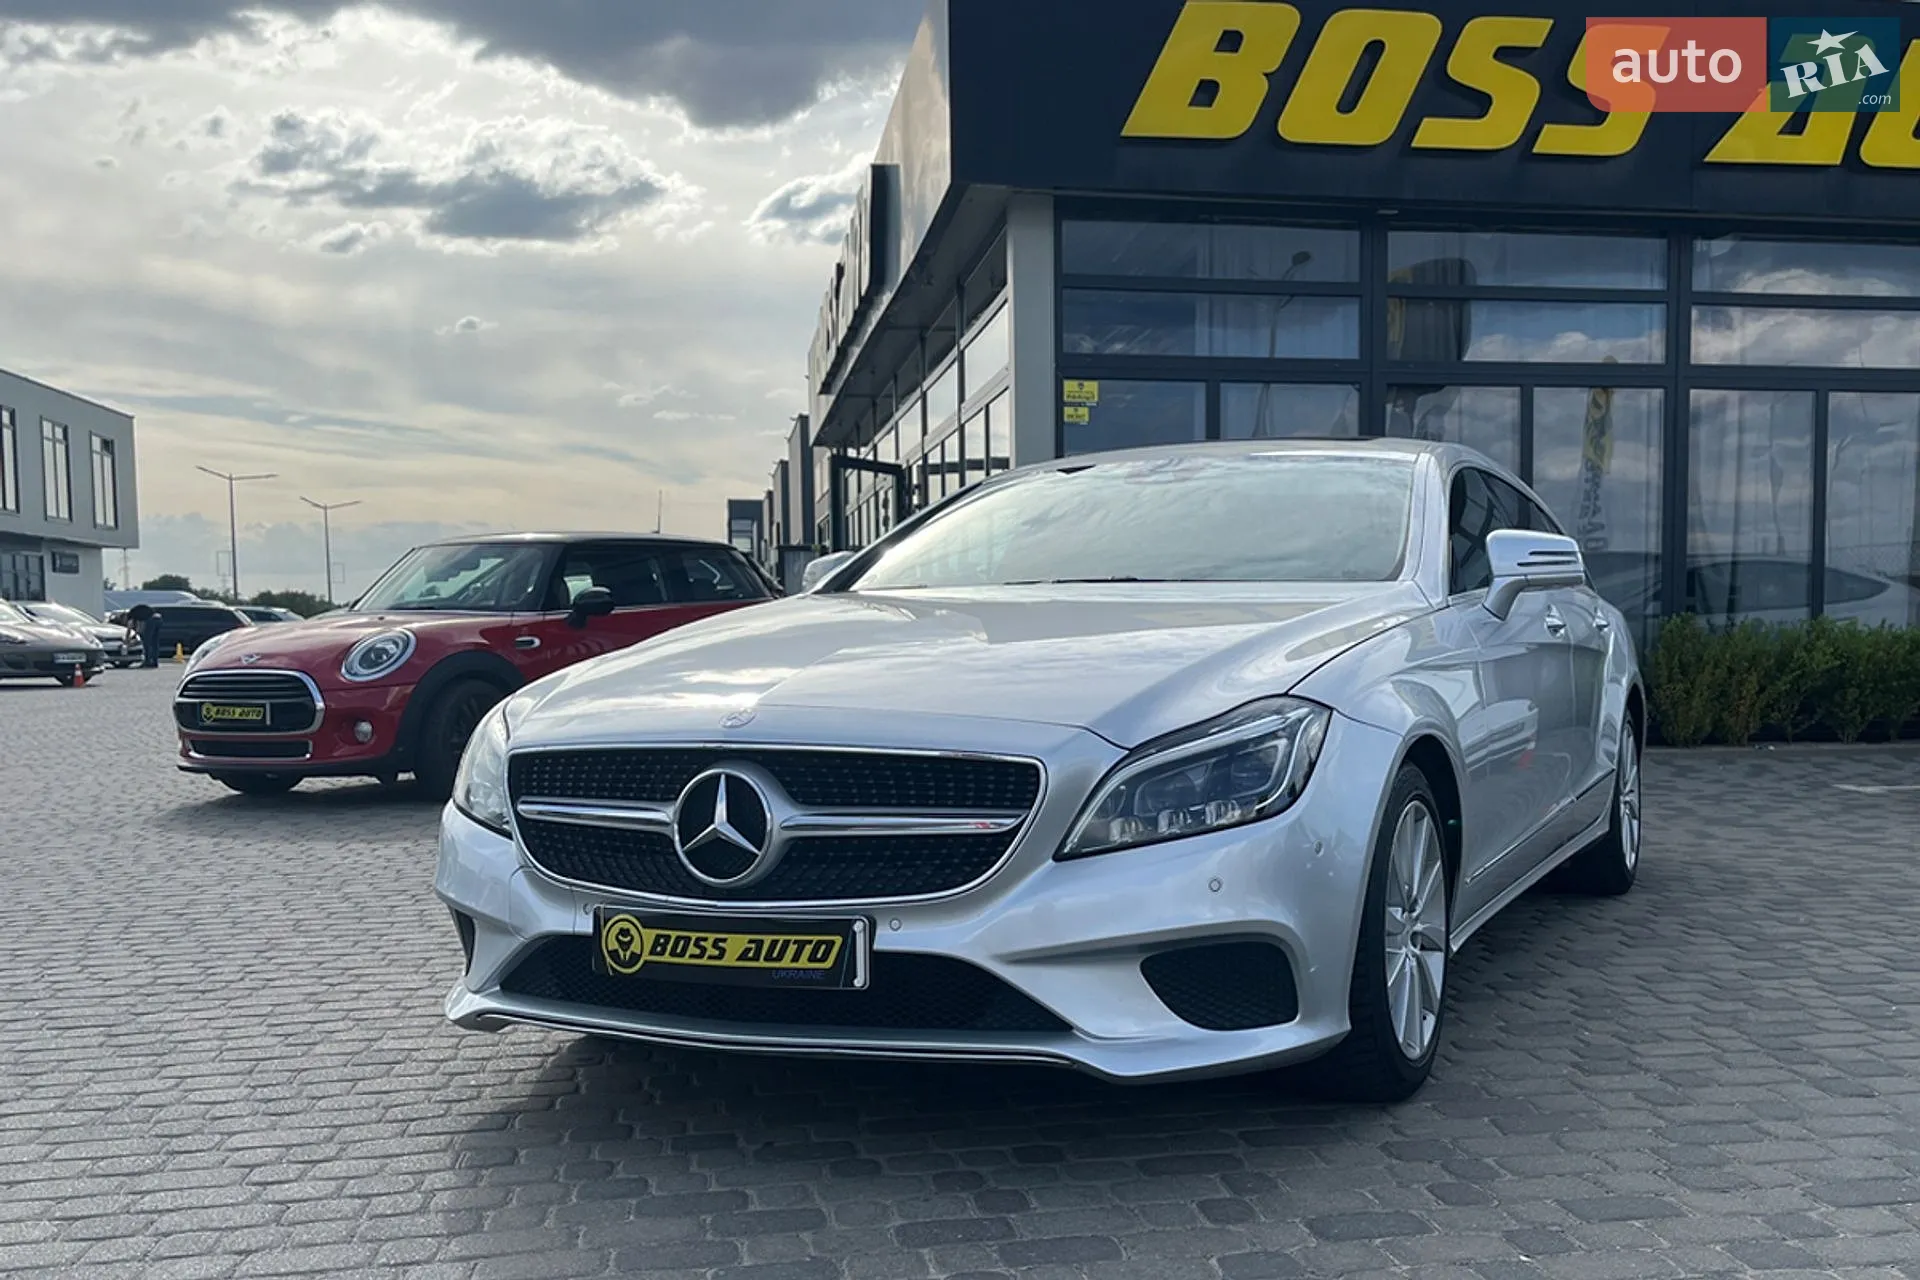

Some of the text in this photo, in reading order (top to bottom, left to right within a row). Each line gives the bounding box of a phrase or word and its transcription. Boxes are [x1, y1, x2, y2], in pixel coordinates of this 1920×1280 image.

[1121, 0, 1671, 156] BOSS
[648, 933, 837, 963] BOSS AUTO
